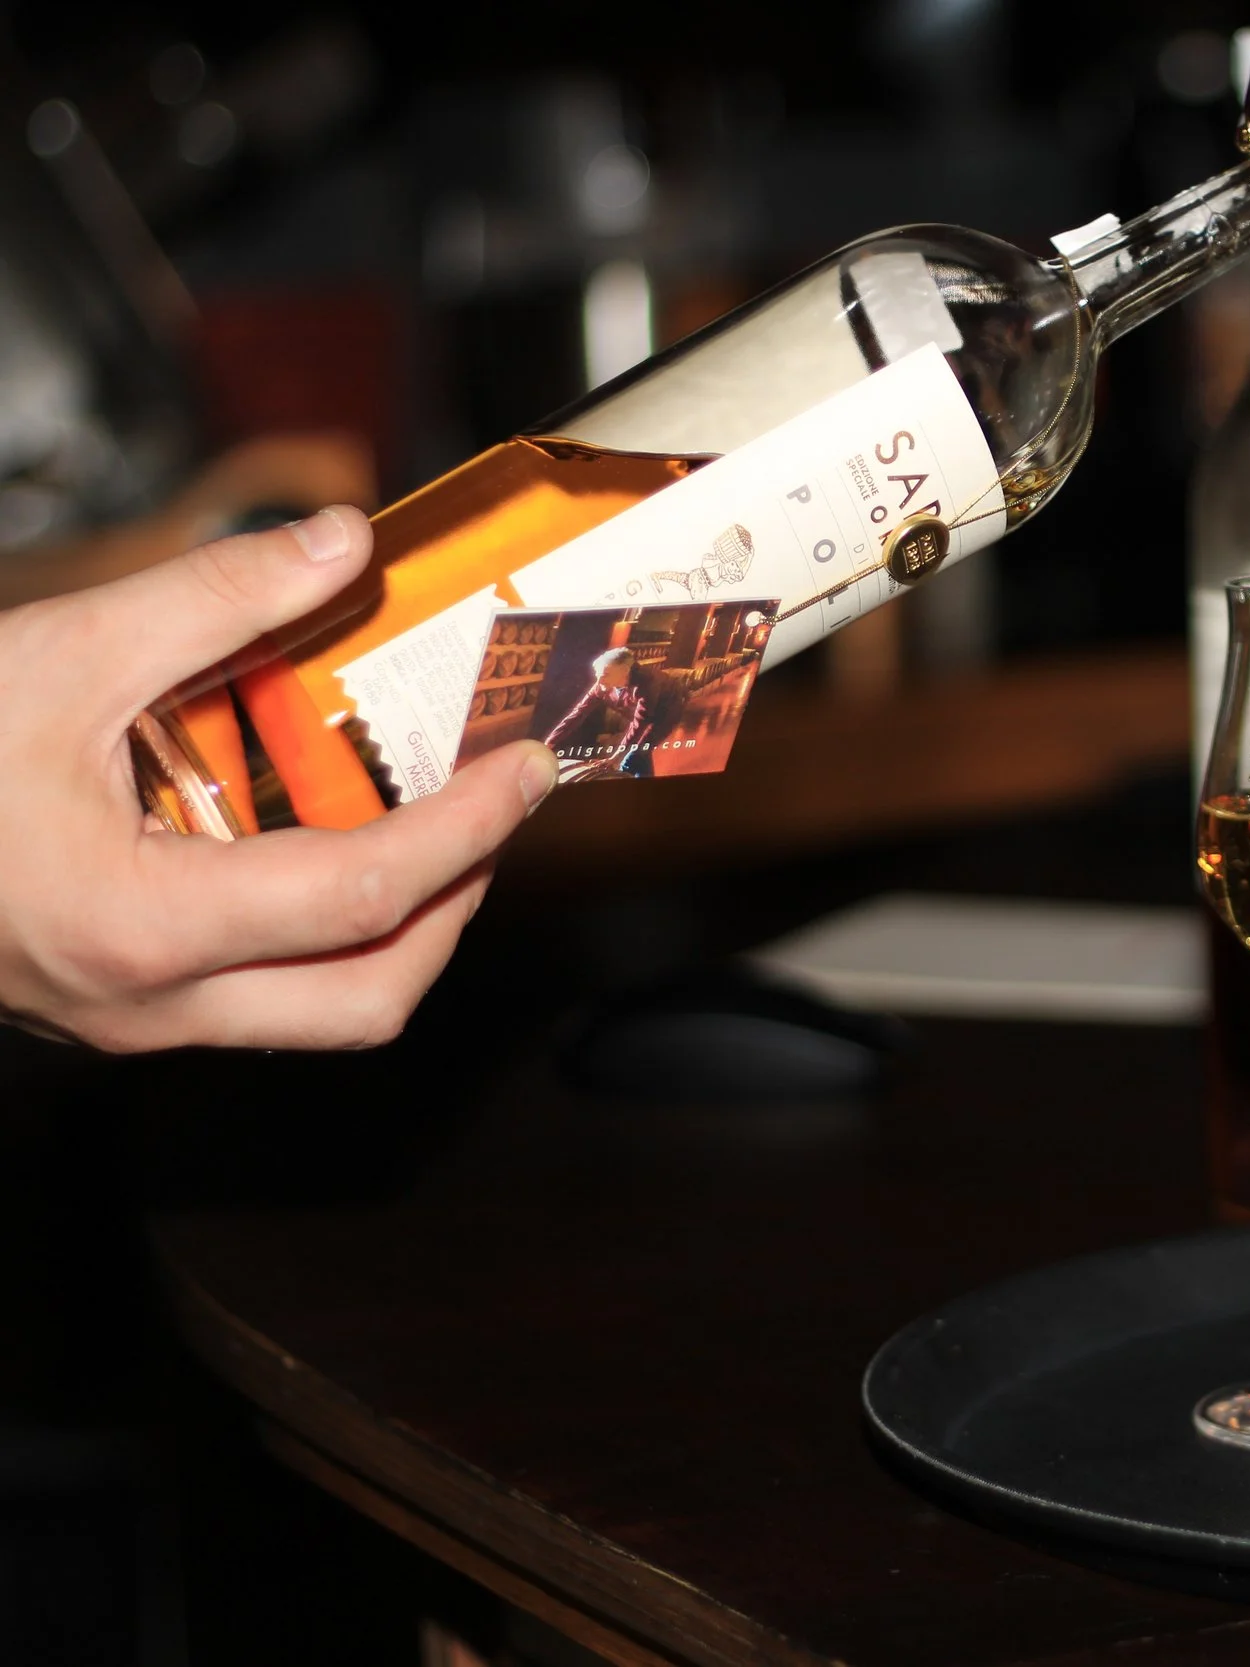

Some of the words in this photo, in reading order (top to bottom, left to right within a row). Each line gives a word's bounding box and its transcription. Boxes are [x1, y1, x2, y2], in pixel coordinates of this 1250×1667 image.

[846, 458, 870, 502] SPECIALE
[854, 454, 879, 497] EDIZIONE
[853, 543, 869, 565] DI
[408, 731, 441, 792] GIUSEPPE
